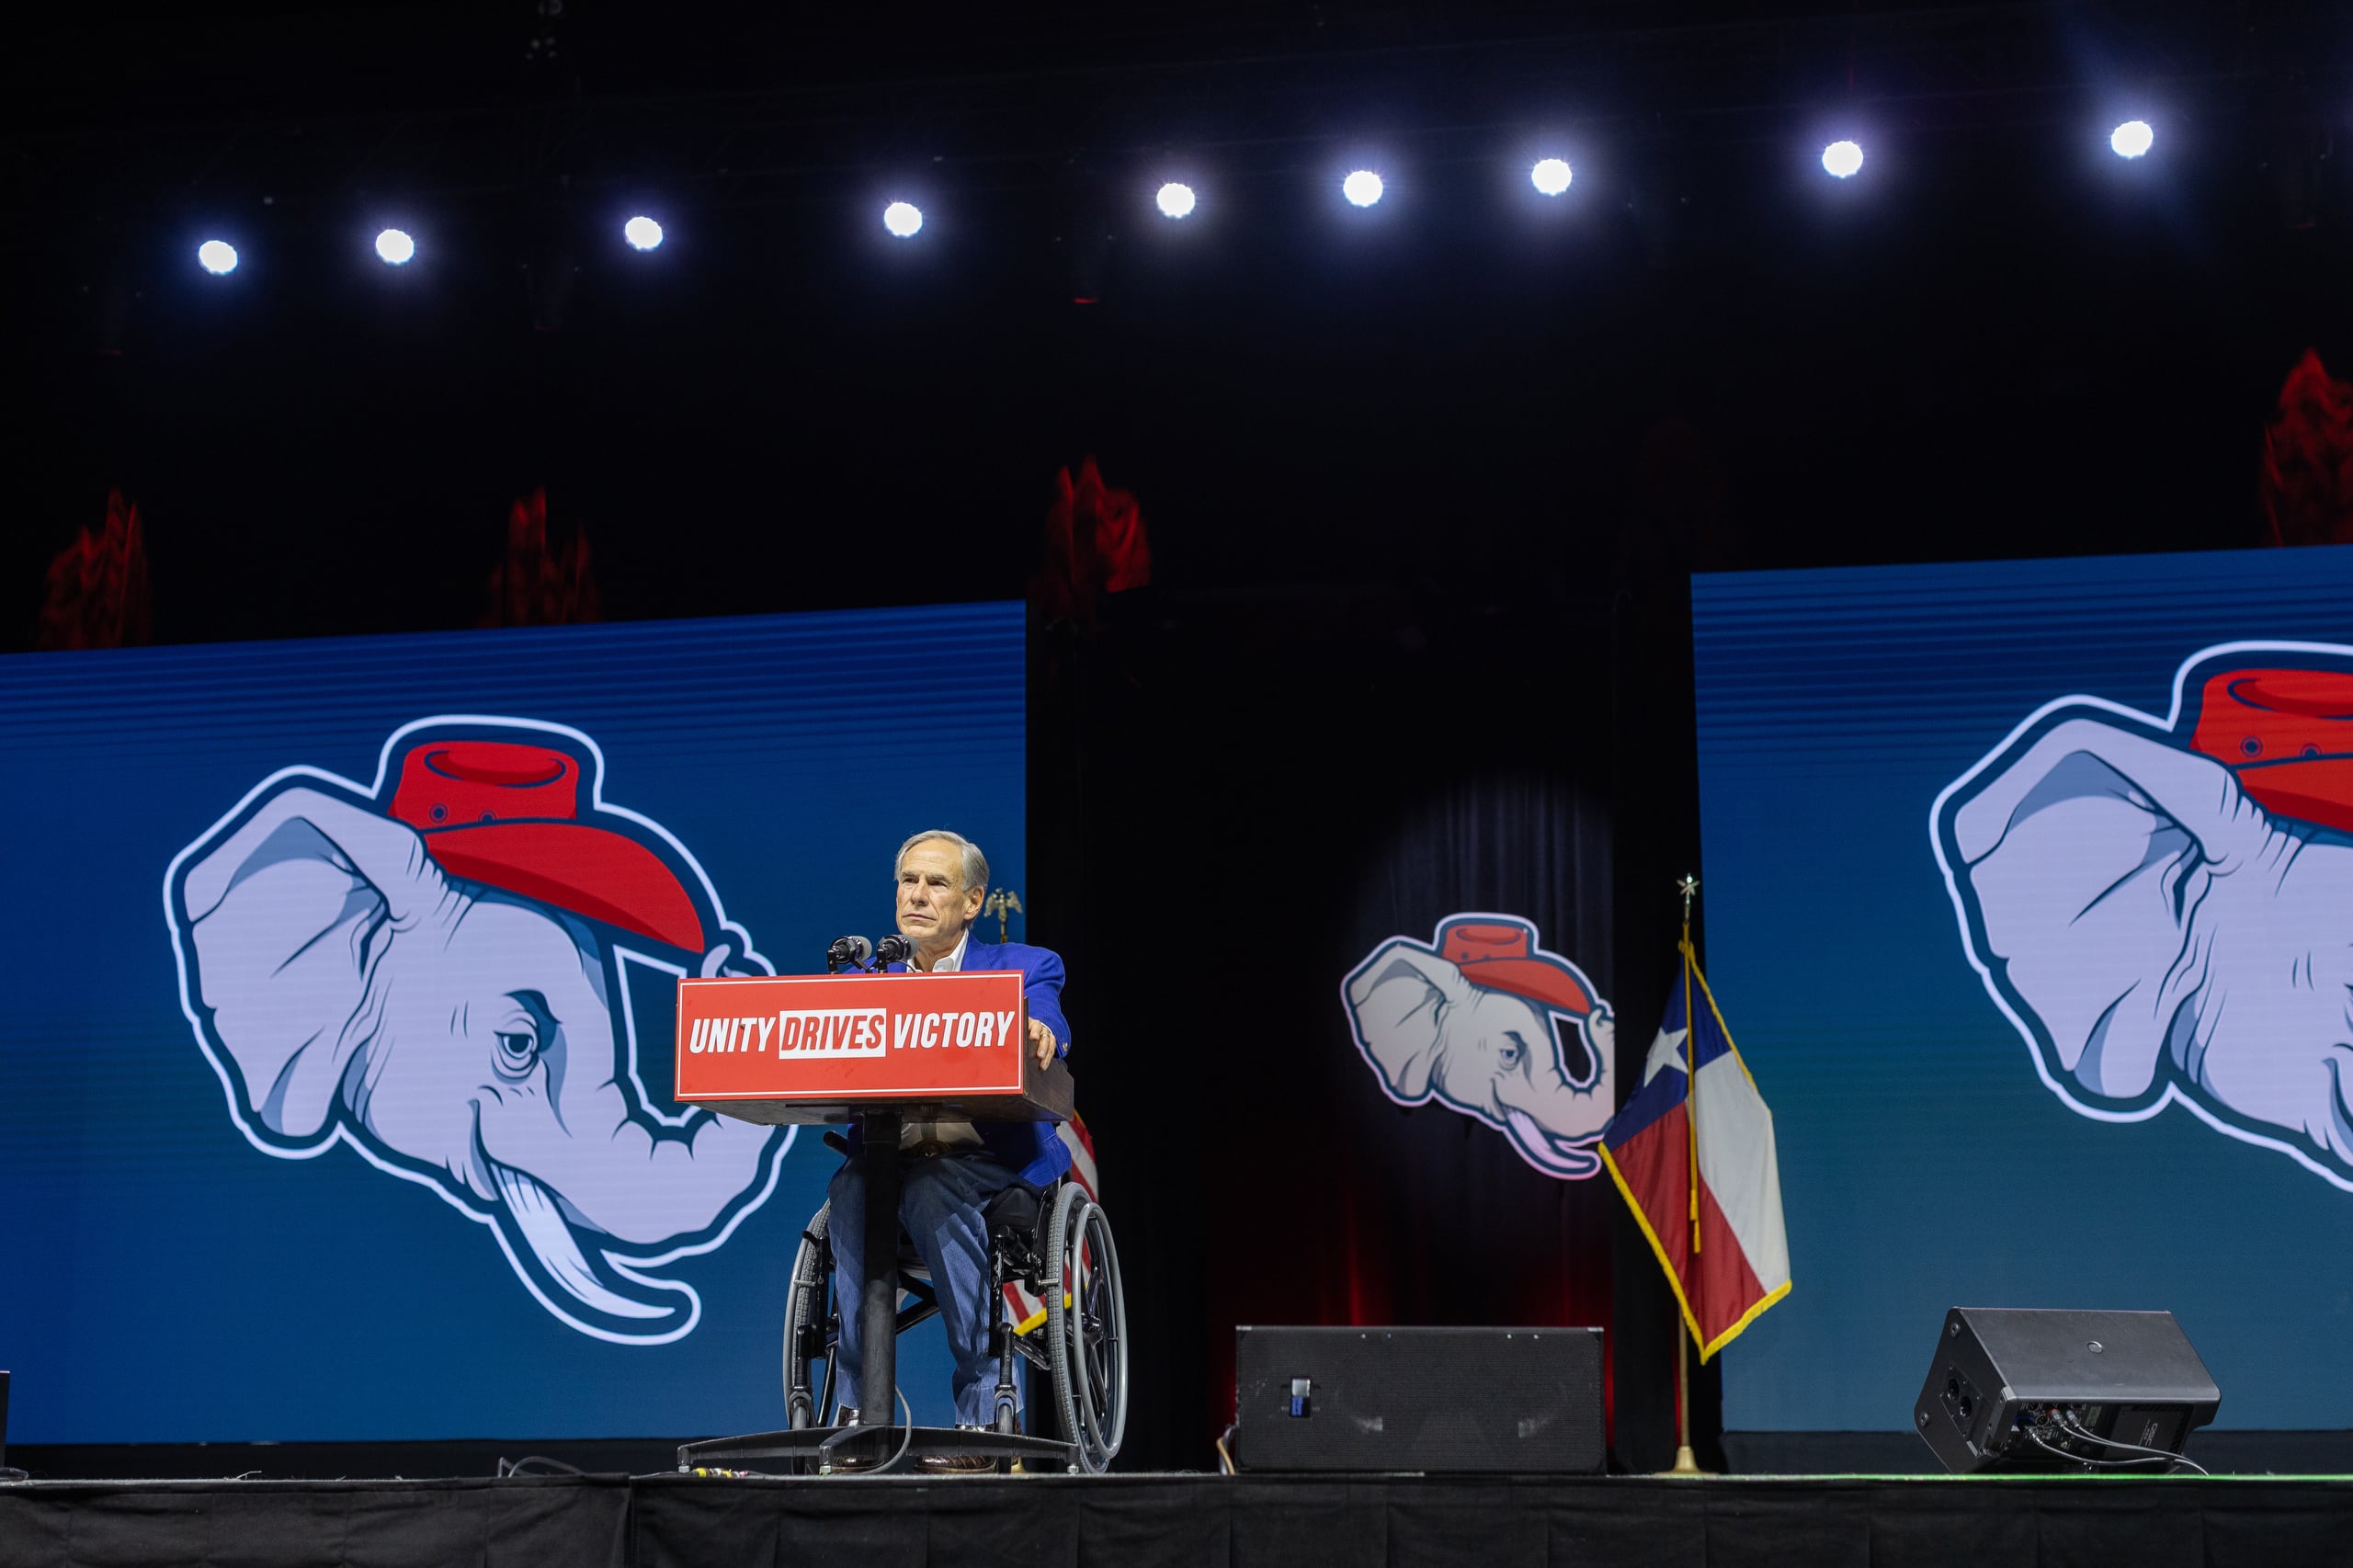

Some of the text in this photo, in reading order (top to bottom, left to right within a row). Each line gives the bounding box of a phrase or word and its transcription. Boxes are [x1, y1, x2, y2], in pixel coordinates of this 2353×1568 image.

[689, 1011, 1016, 1054] UNITY DRIVES VICTORY
